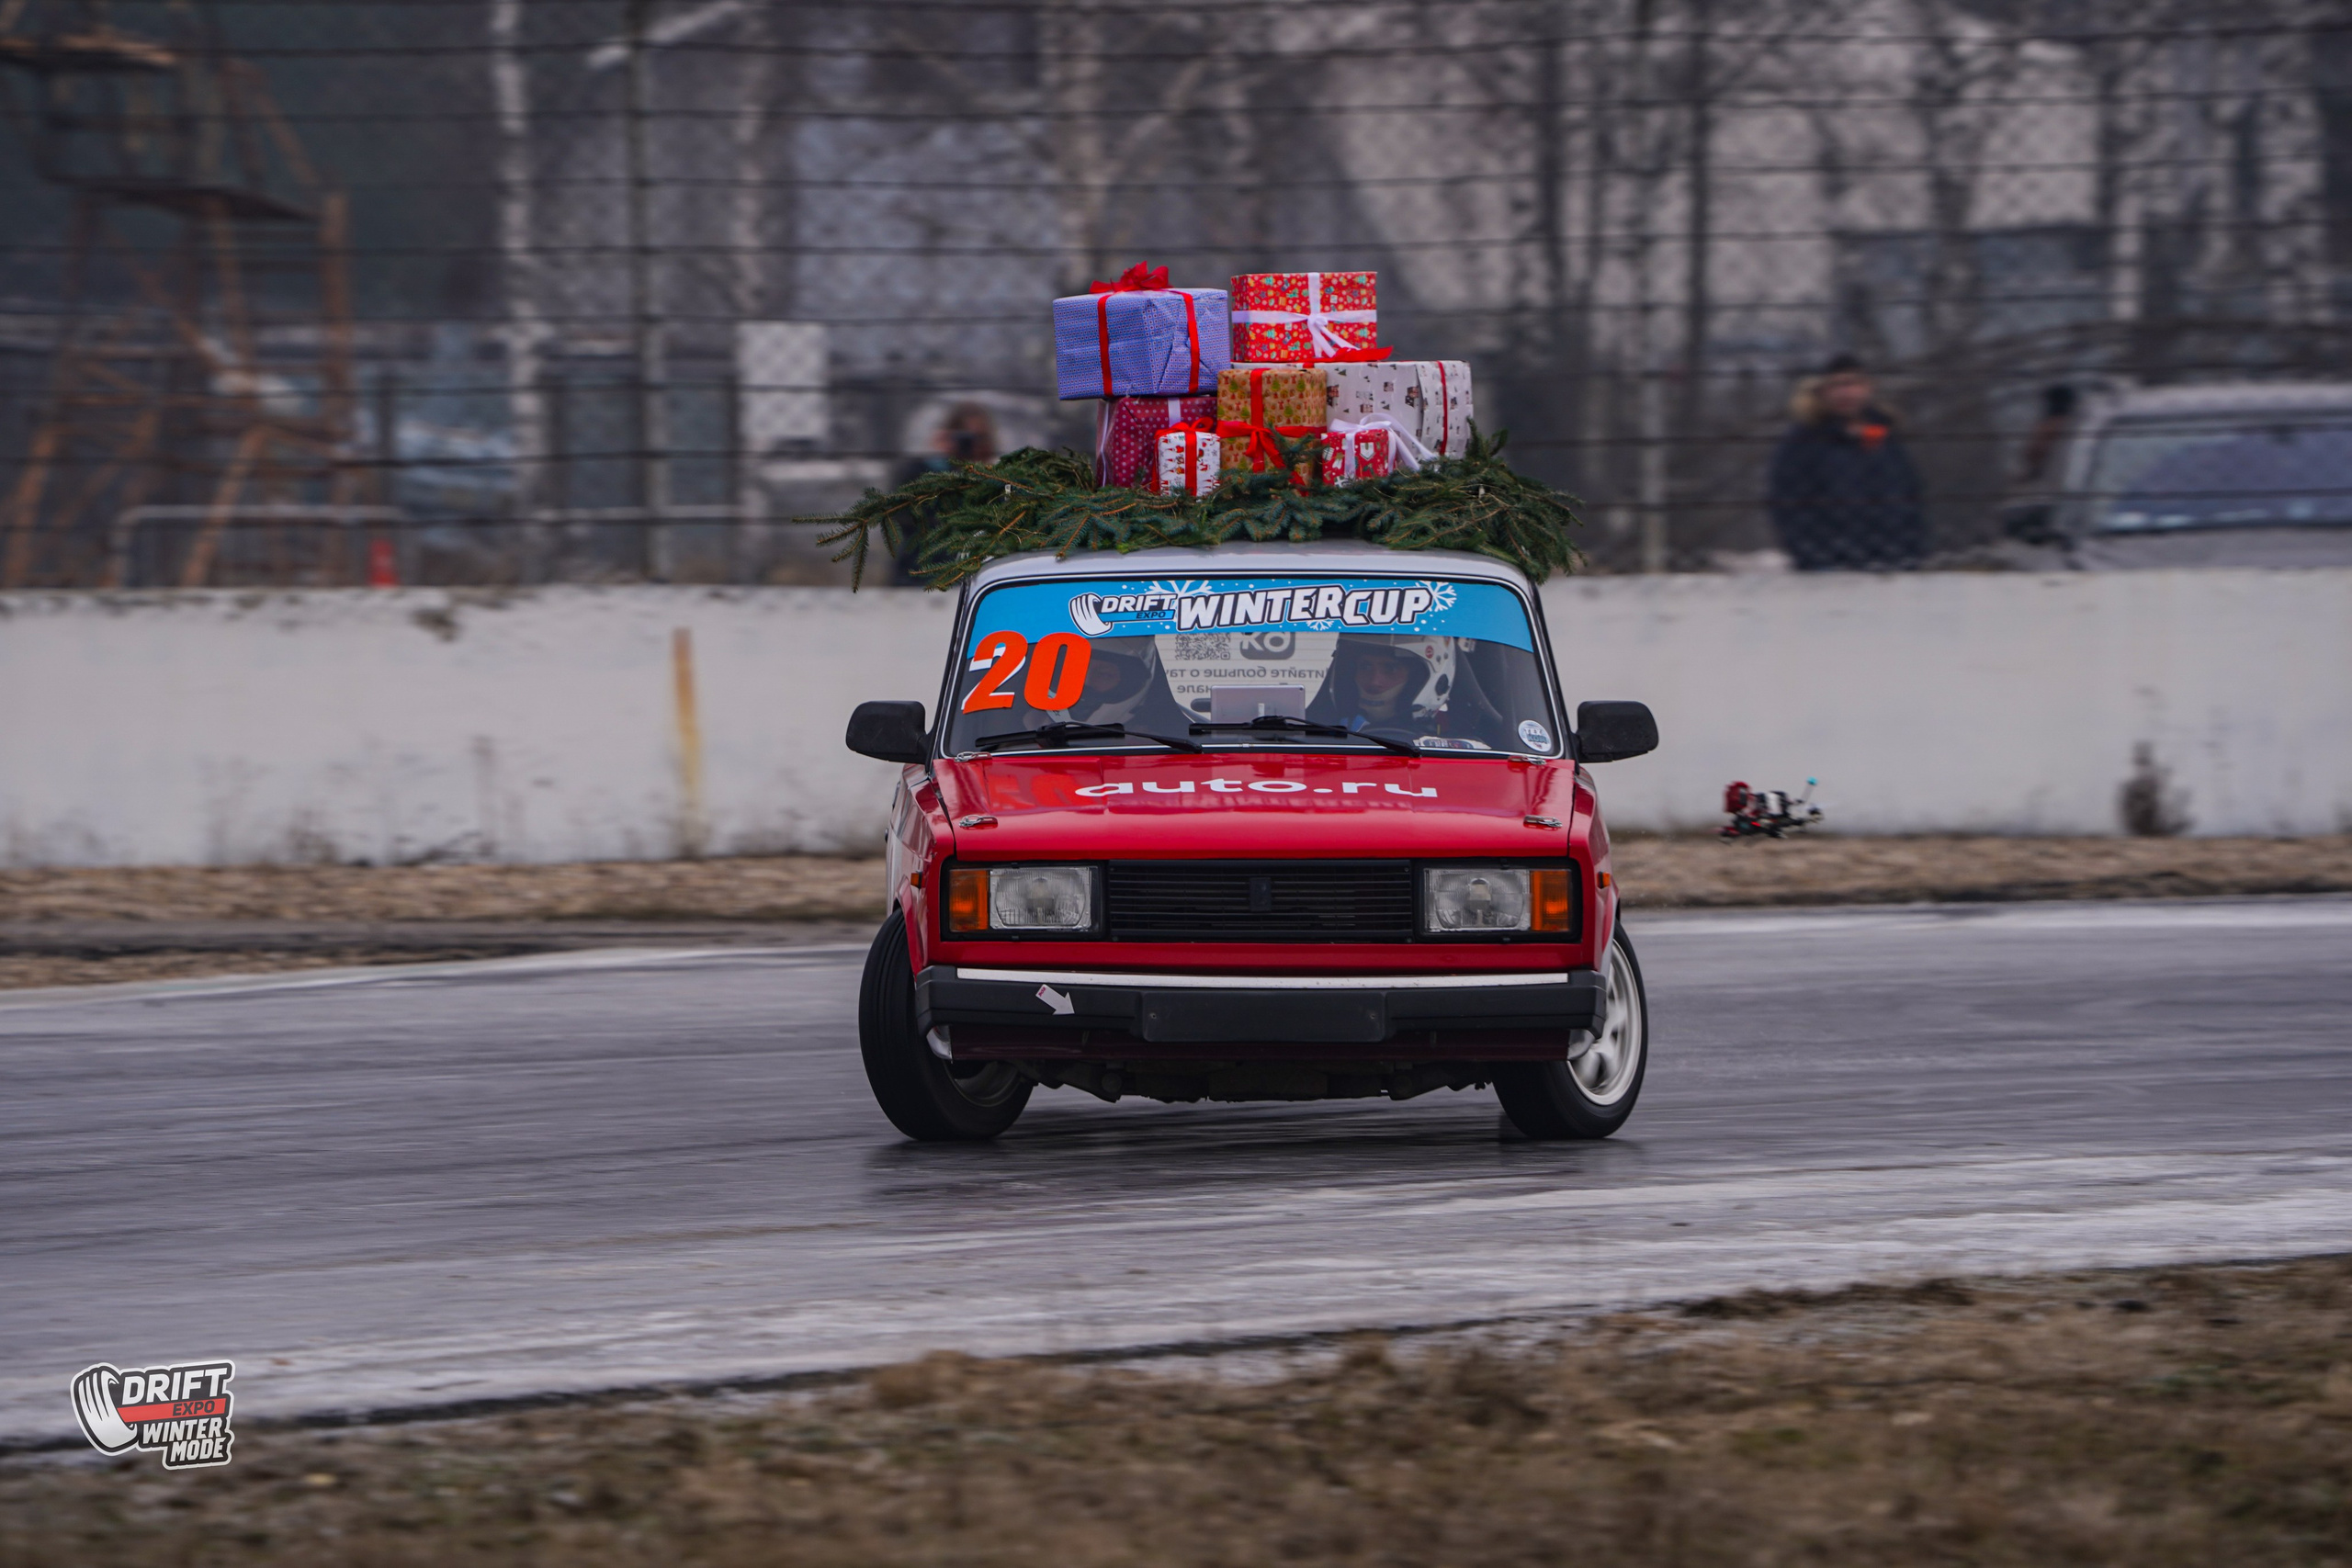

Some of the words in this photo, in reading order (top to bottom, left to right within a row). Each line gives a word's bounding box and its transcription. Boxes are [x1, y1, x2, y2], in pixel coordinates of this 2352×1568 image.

[1101, 594, 1177, 613] DRIFT
[1136, 611, 1166, 619] EXPO
[961, 630, 1091, 715] 20
[1075, 778, 1438, 798] auto.ru
